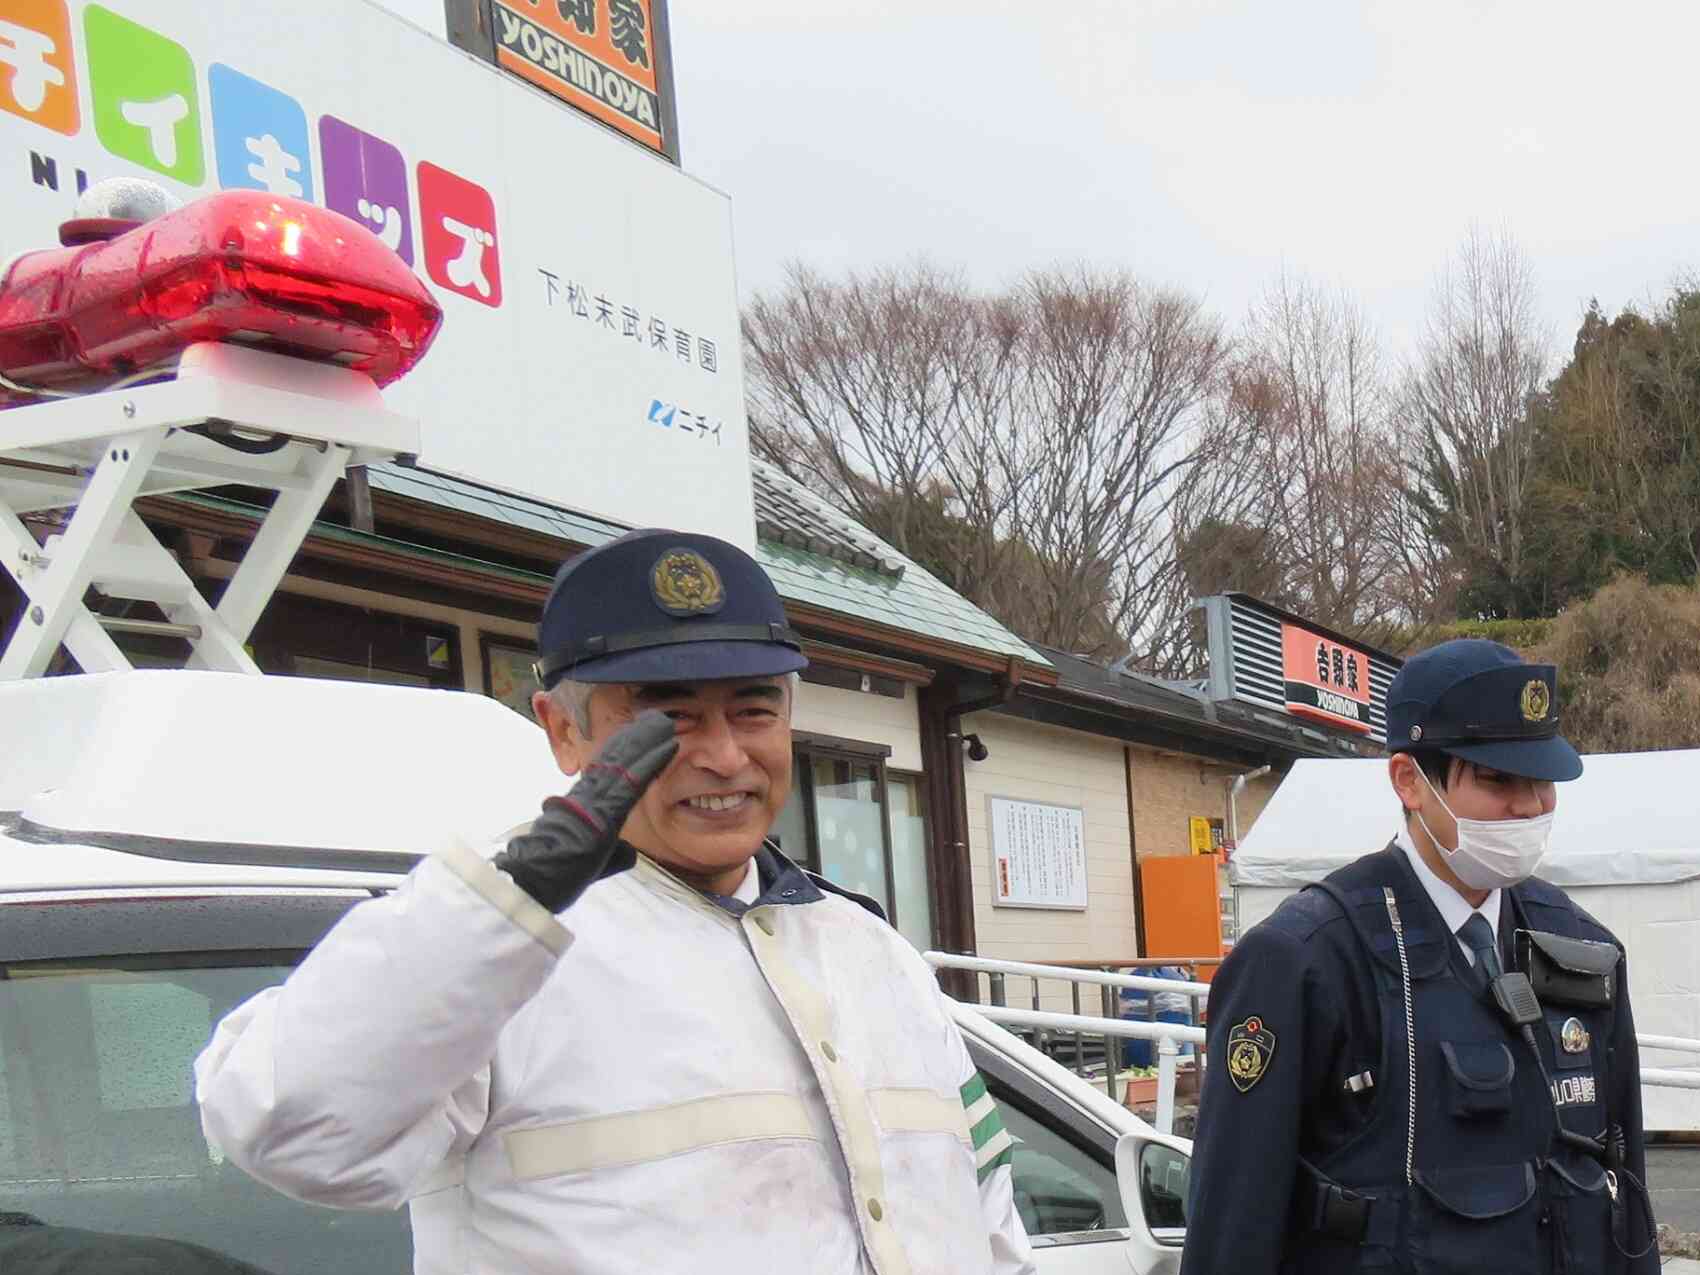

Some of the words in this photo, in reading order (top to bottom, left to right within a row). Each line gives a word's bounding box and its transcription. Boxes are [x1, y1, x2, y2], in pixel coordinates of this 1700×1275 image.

[499, 8, 657, 129] YOSHINOYA
[537, 267, 718, 373] 下松末武保育園
[679, 409, 723, 447] ニチイ
[1316, 641, 1359, 693] 吉野家
